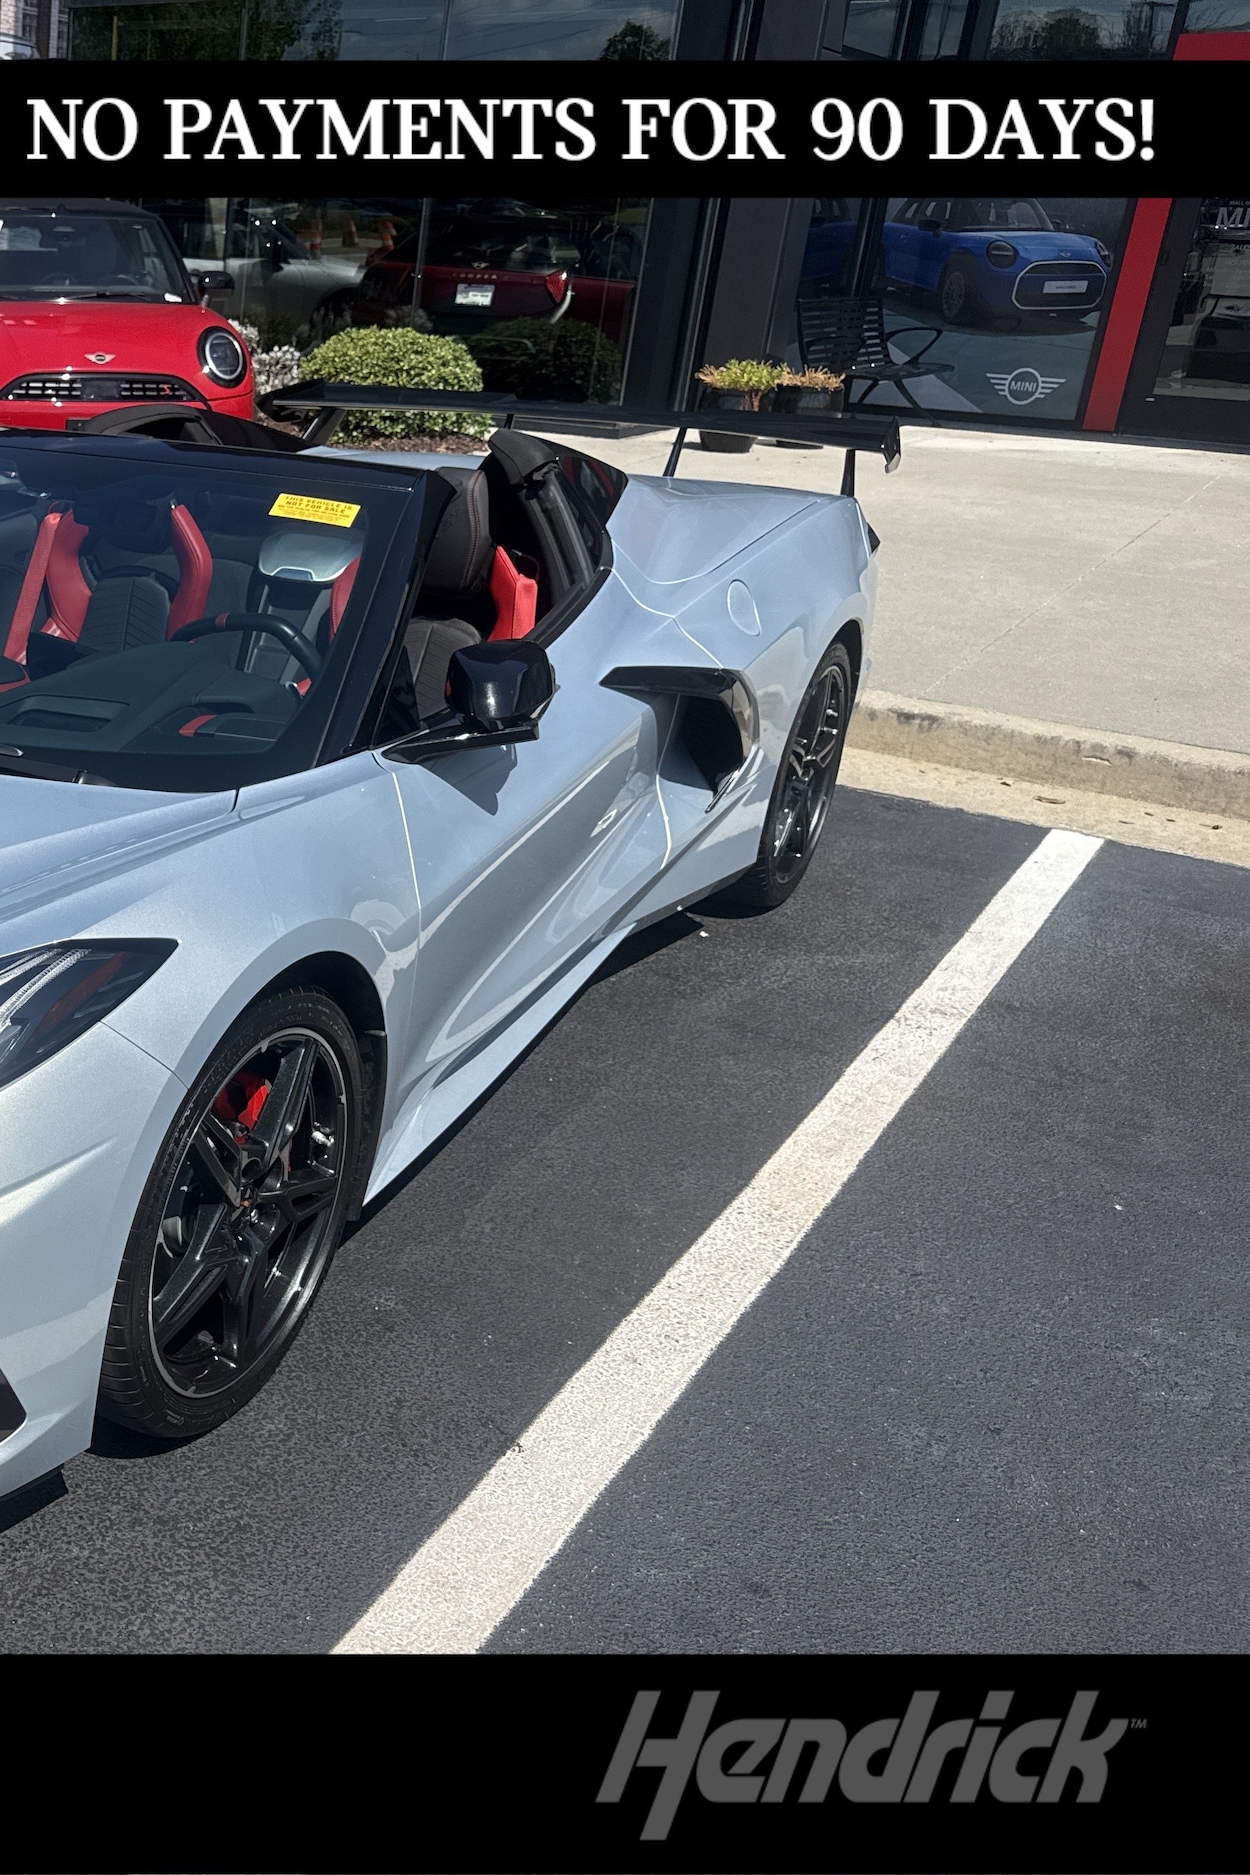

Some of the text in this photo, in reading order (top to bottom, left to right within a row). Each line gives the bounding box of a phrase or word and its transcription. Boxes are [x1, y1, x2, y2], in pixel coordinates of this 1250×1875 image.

[1010, 381, 1037, 392] MINI
[307, 498, 341, 508] VEHICLE
[324, 506, 346, 514] SALE
